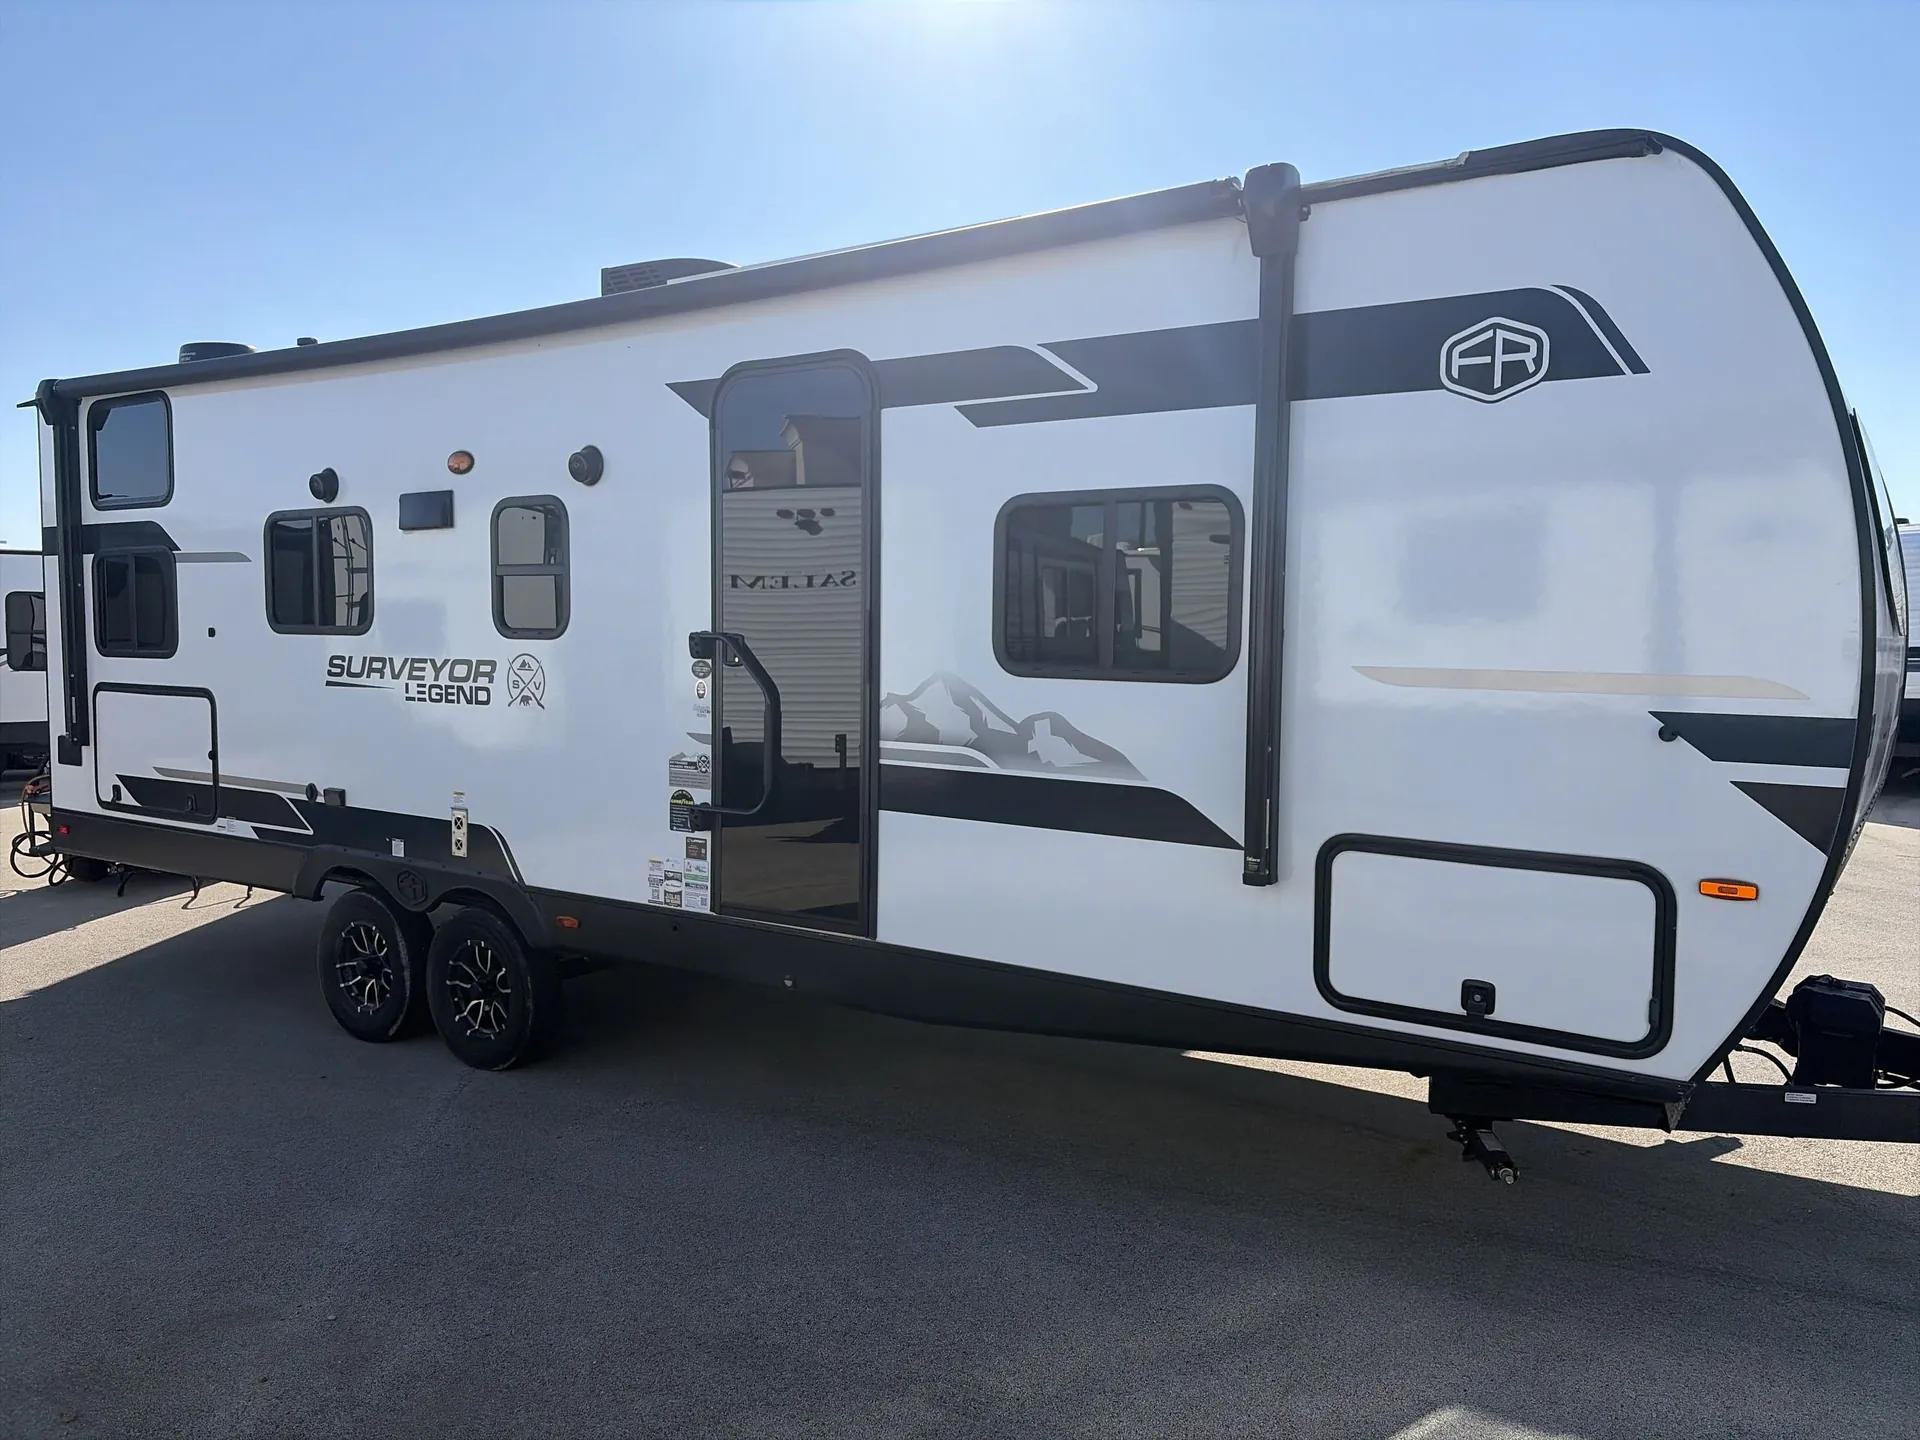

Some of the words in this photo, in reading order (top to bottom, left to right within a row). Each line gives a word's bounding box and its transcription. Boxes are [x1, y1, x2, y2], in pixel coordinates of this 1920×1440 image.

[326, 654, 498, 684] SURVEYOR
[405, 683, 491, 706] LEGEND
[512, 679, 520, 689] S
[533, 681, 542, 691] V
